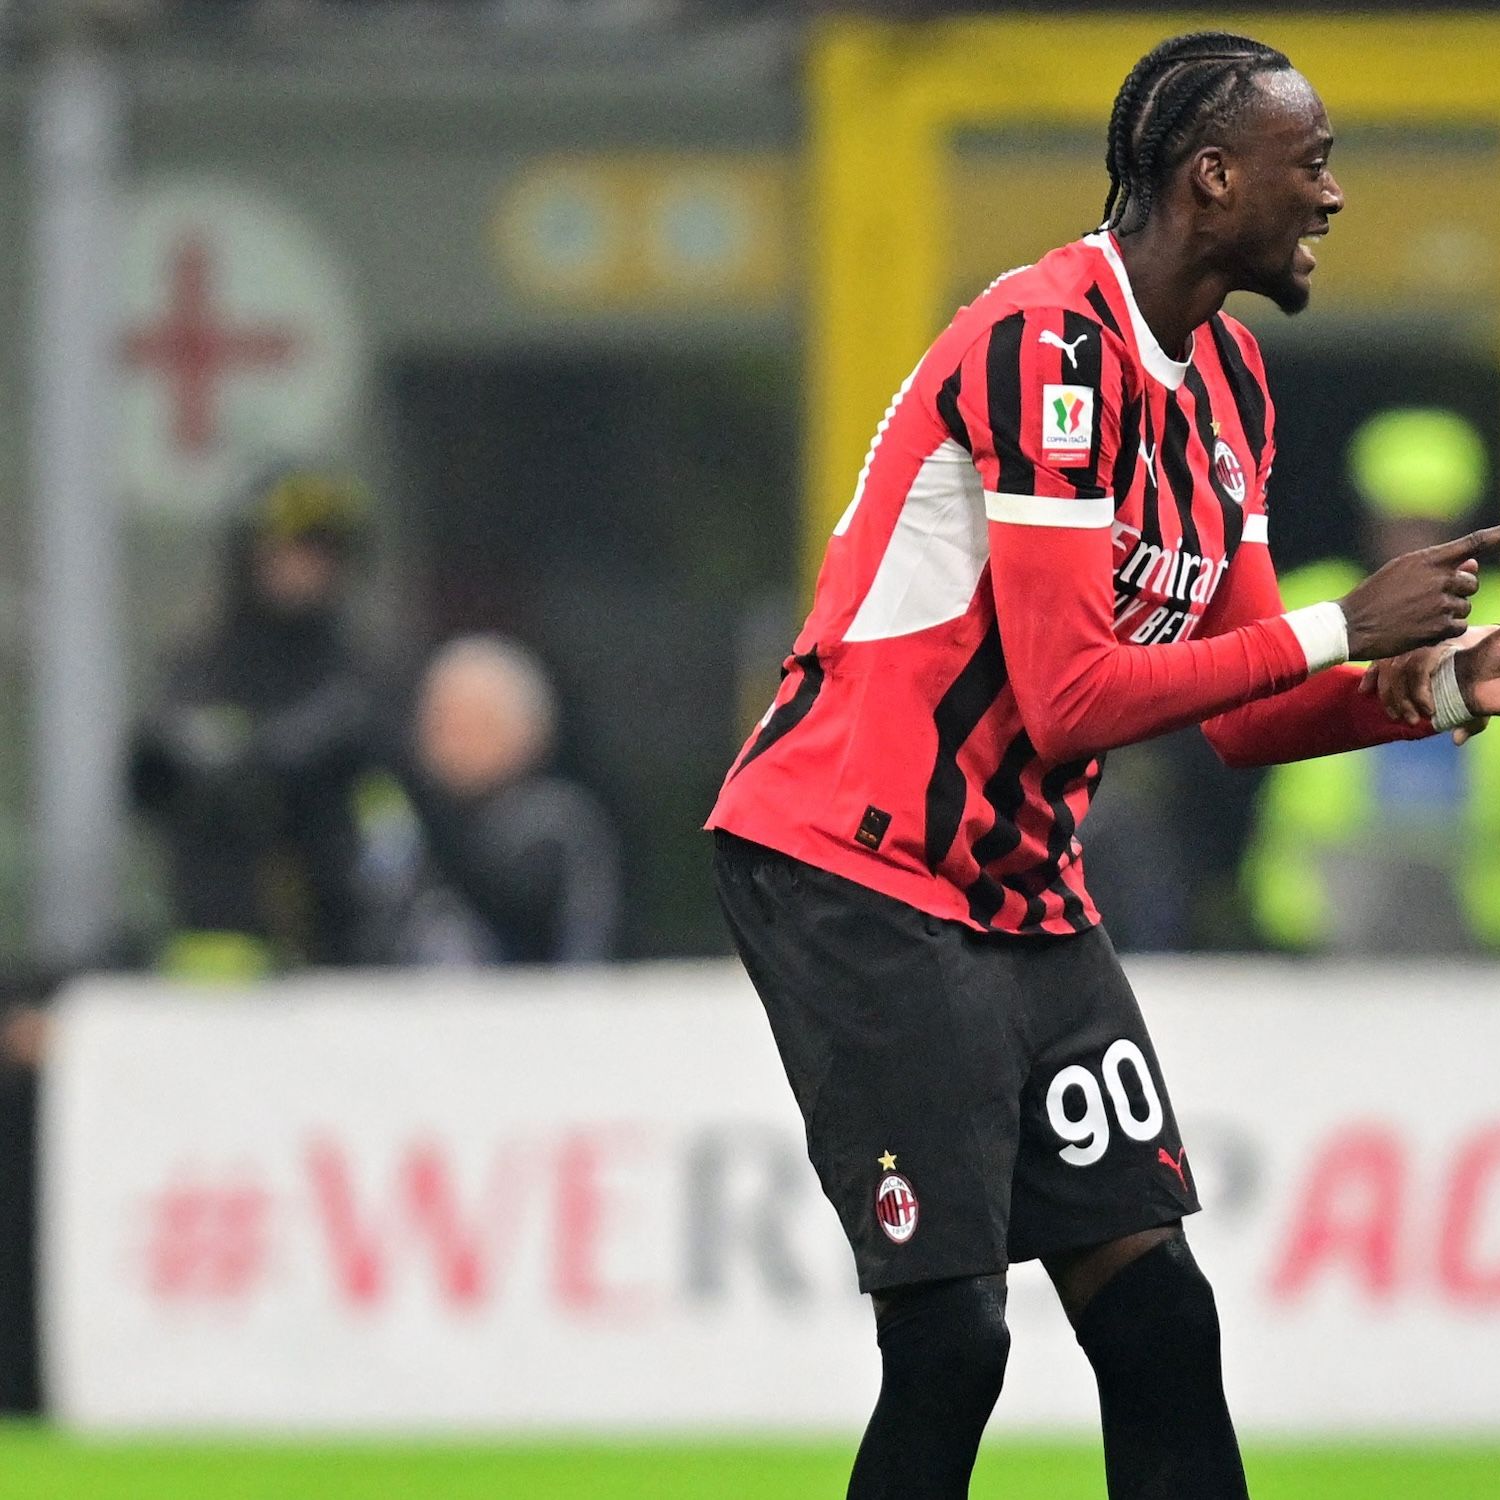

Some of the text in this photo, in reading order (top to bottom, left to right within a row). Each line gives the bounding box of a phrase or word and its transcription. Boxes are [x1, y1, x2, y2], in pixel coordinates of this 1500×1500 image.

[1111, 520, 1229, 604] Emirat
[1046, 1039, 1163, 1166] 90
[883, 1178, 905, 1190] ACM
